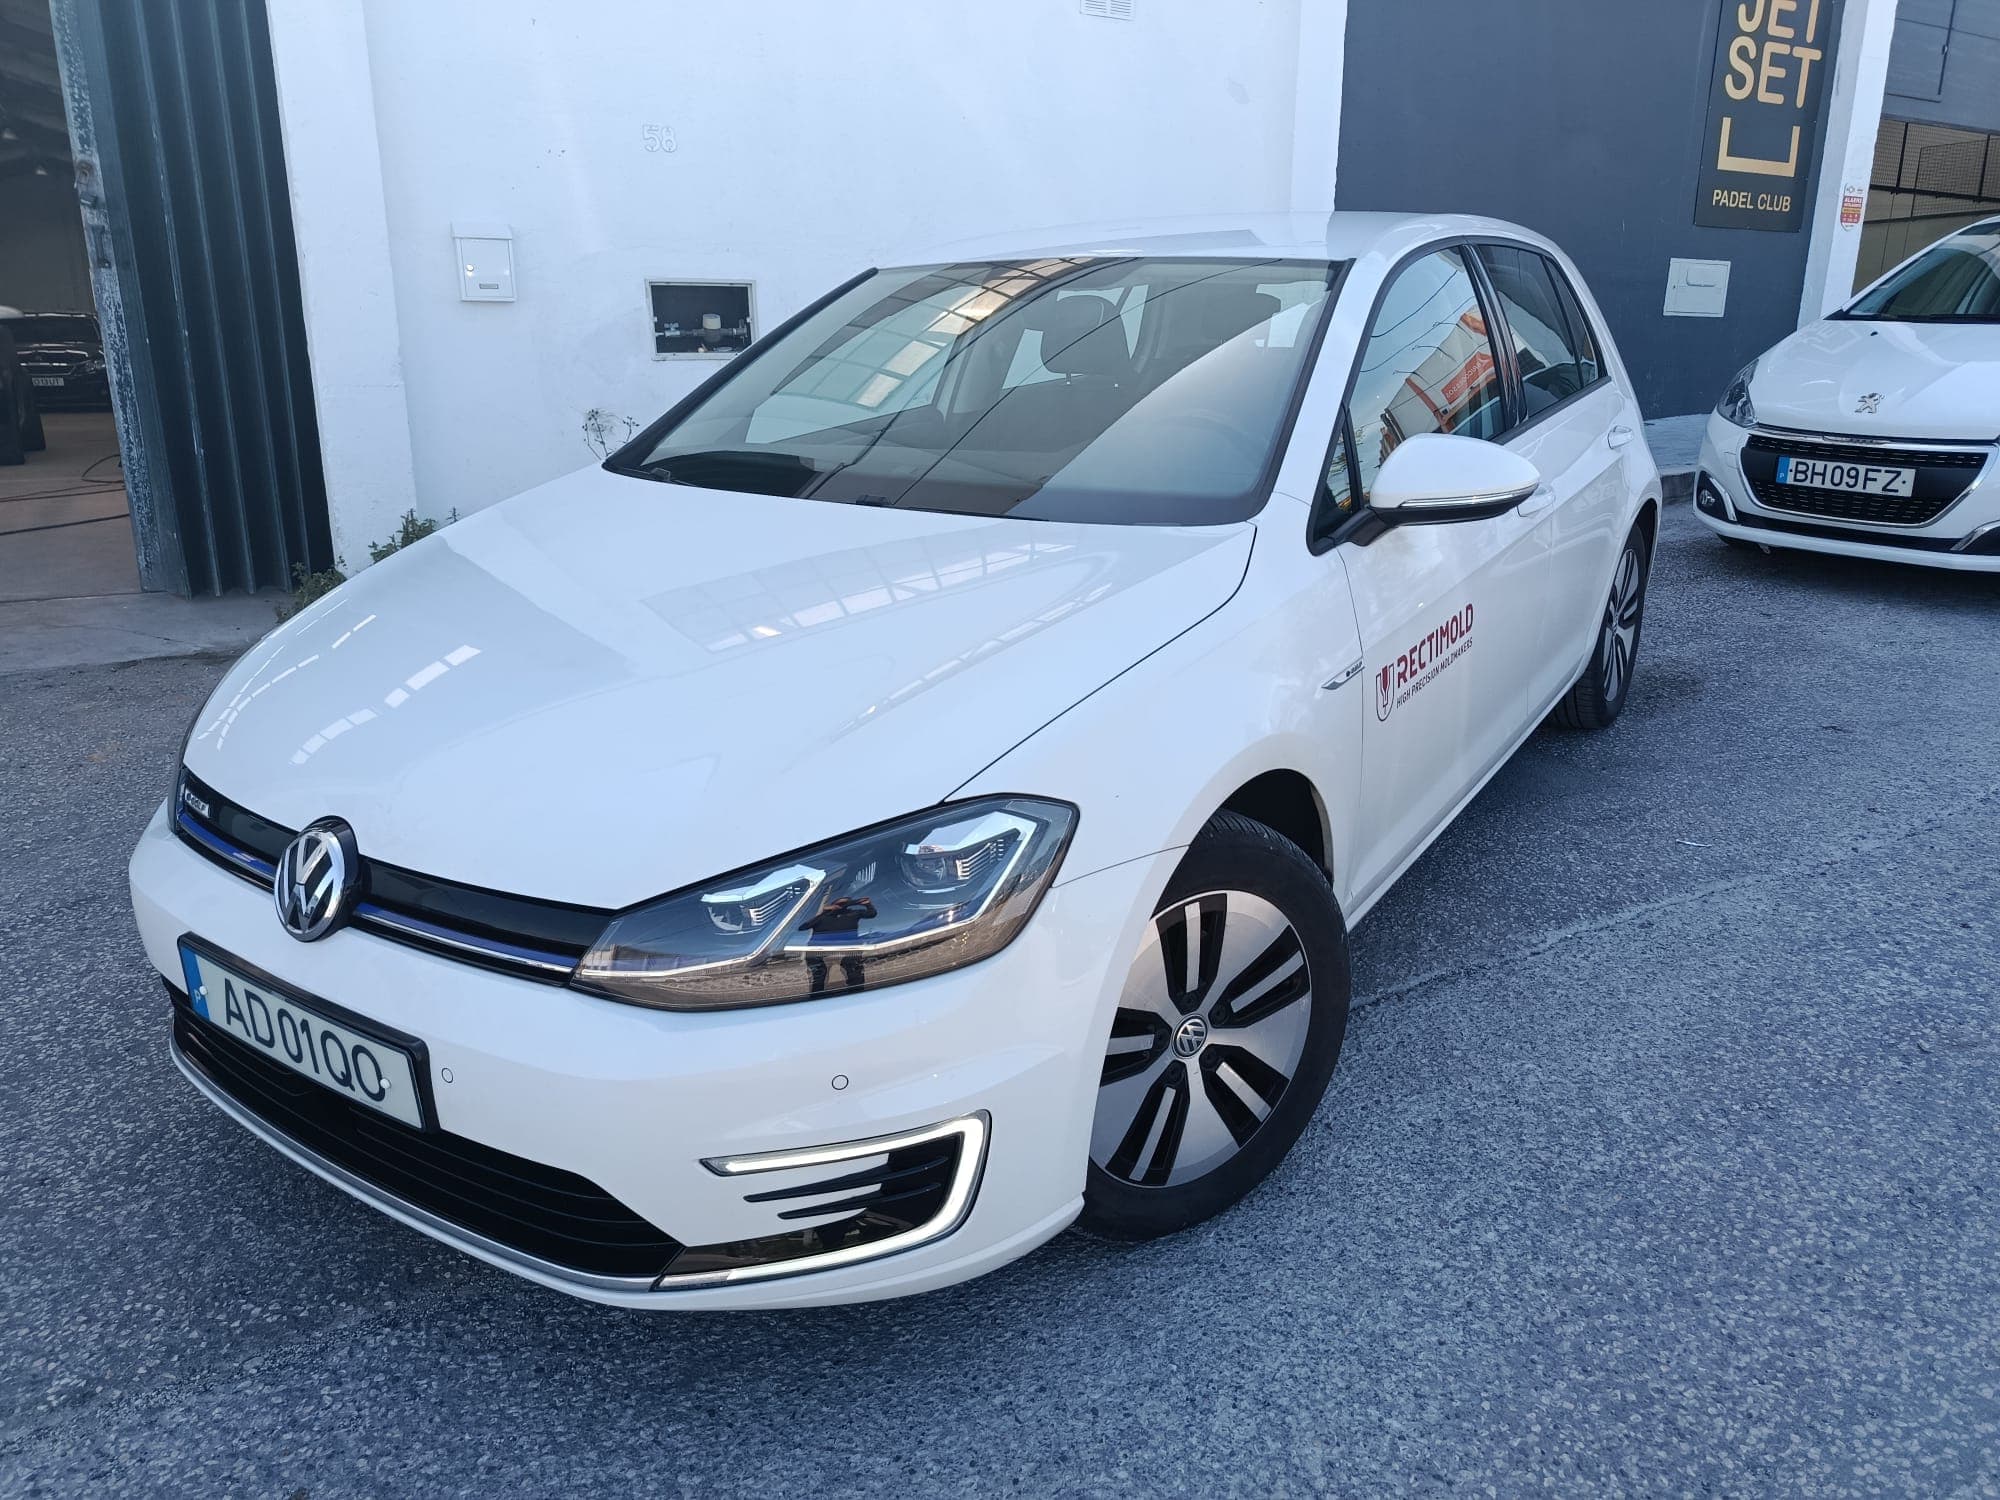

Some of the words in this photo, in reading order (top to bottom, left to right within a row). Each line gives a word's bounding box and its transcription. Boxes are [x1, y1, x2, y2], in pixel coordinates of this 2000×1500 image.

[1725, 36, 1822, 109] SET
[641, 124, 678, 153] 58
[1712, 189, 1754, 209] PADEL
[1757, 193, 1791, 212] CLUB
[1793, 461, 1902, 493] BH09FZ
[1396, 603, 1474, 689] RECTIMOLD
[1396, 688, 1411, 708] HIGH
[1411, 664, 1440, 696] PRECISION
[1440, 636, 1473, 673] MOLDMAKERS
[224, 977, 386, 1102] AD01QO
